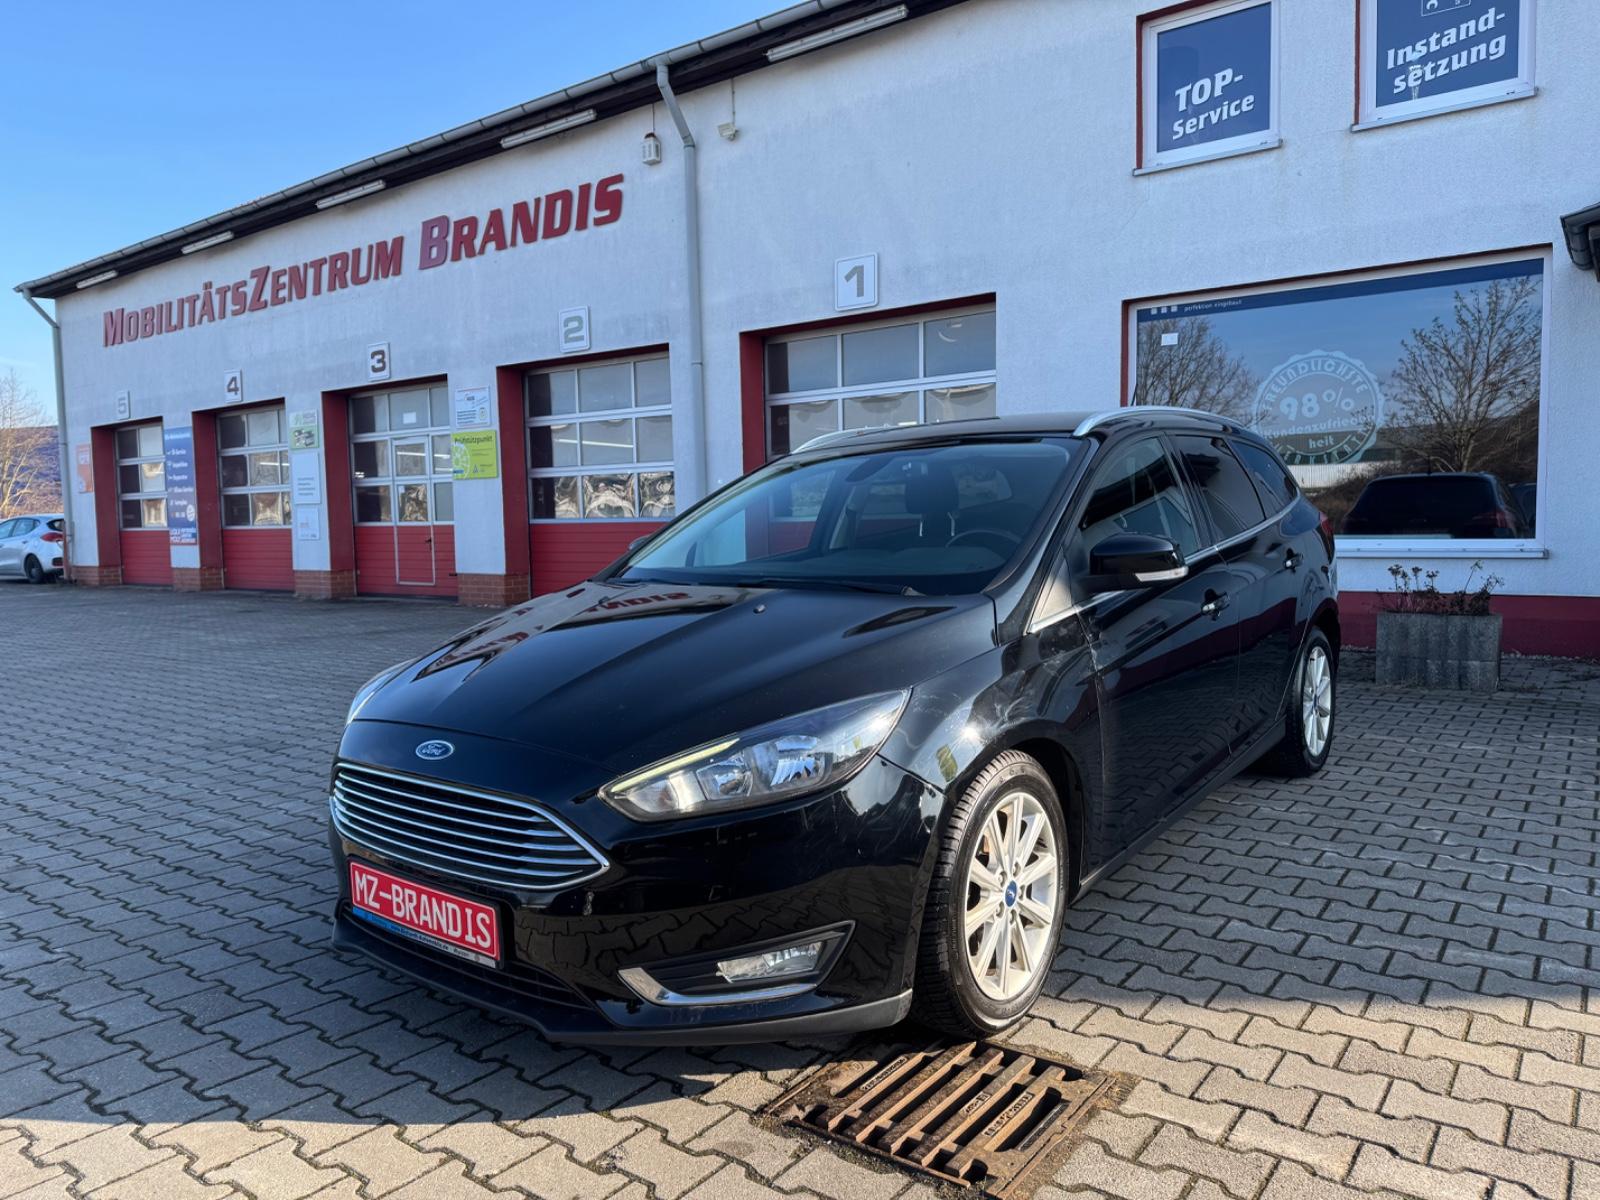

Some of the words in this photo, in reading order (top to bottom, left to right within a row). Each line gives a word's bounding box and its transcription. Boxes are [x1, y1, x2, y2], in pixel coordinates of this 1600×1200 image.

[1386, 7, 1506, 71] Instand-
[1392, 34, 1507, 95] setzung
[1175, 67, 1244, 112] TOP-
[1172, 93, 1255, 141] Service
[844, 264, 865, 298] 1
[563, 315, 585, 344] 2
[370, 349, 387, 373] 3
[226, 375, 240, 396] 4
[117, 397, 128, 414] 5
[1308, 435, 1335, 449] heit
[354, 869, 492, 949] MZ-BRANDIS
